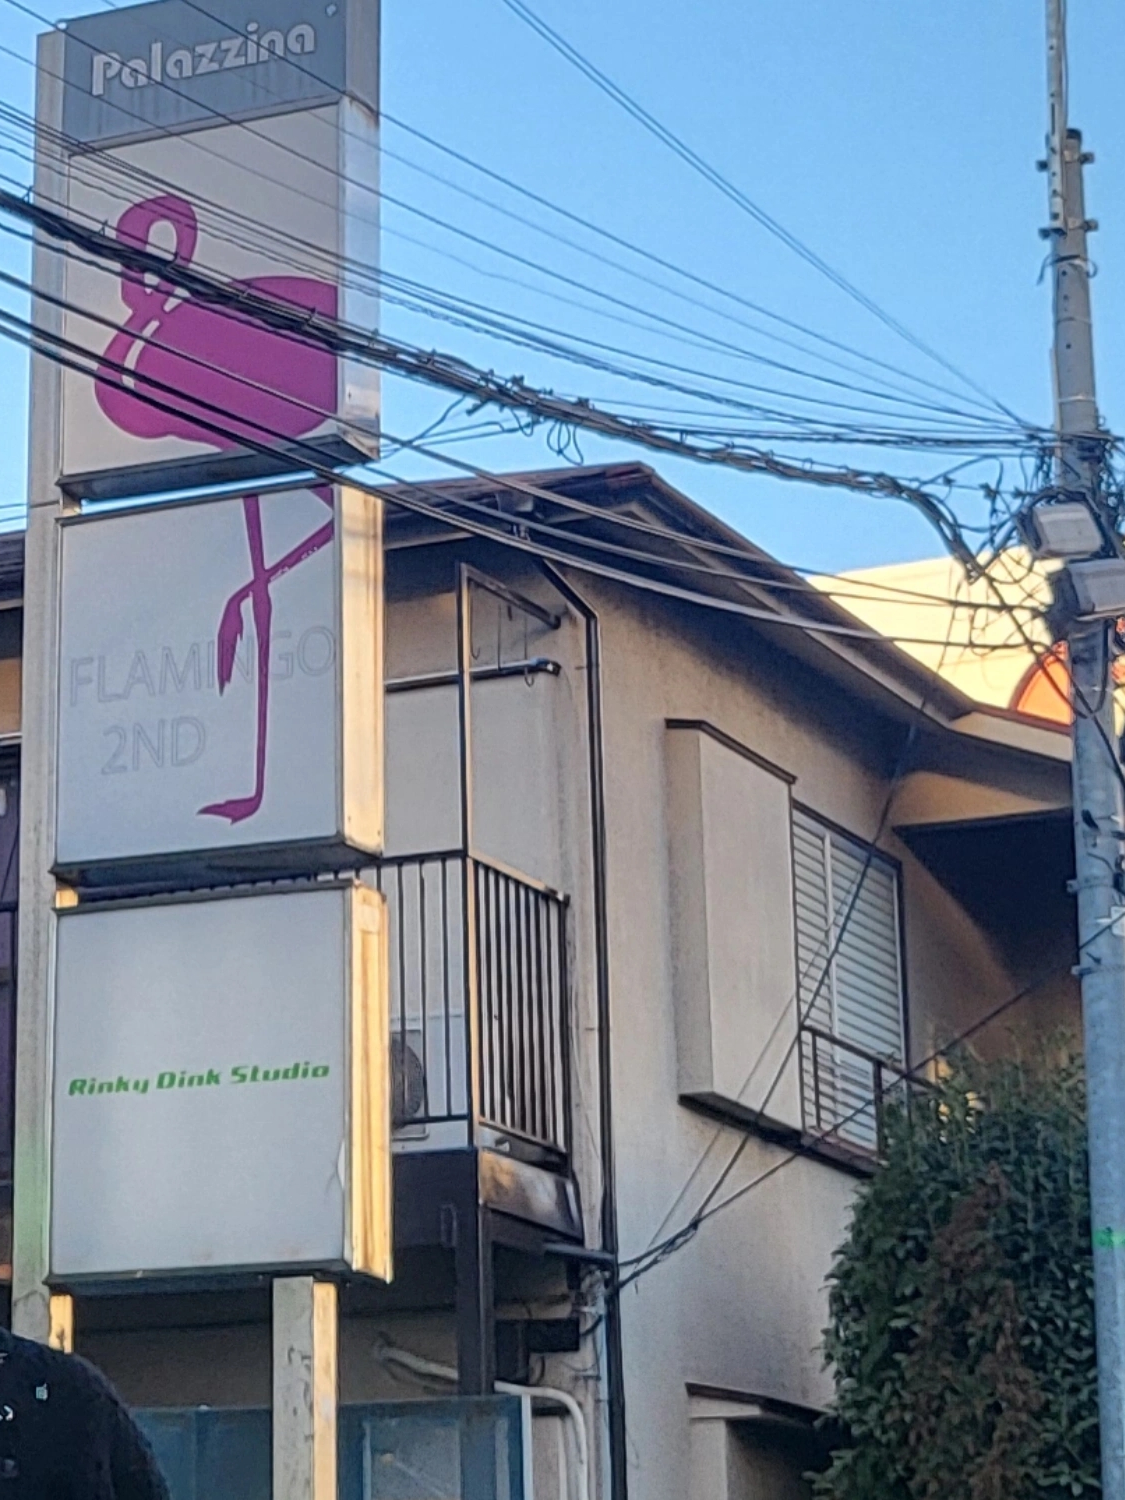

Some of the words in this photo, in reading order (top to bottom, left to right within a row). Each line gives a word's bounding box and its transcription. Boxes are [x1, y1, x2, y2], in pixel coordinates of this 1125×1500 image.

[91, 22, 316, 96] Palazzina
[101, 716, 207, 775] 2ND
[68, 1075, 149, 1096] Rinky
[156, 1068, 221, 1090] Dink
[229, 1061, 330, 1084] Studio
